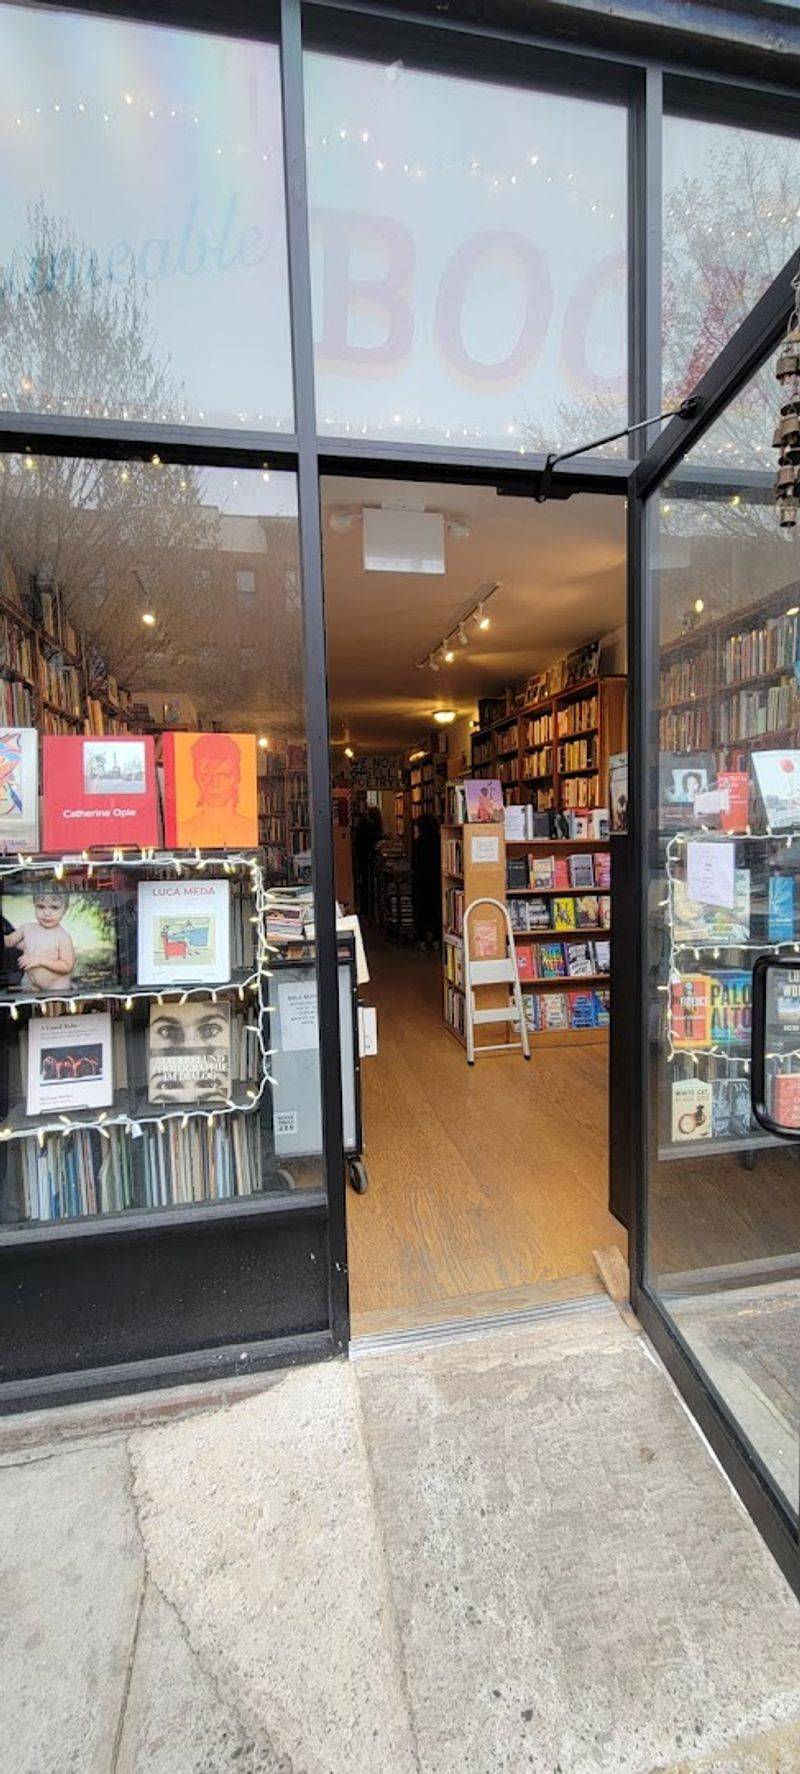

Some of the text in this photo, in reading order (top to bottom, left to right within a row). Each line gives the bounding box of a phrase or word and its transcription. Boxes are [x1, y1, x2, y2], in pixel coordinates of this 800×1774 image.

[62, 807, 136, 818] Catherine Opie
[152, 887, 216, 897] LUCA MEDA
[711, 984, 751, 1006] PALO
[711, 1006, 751, 1031] ALTO
